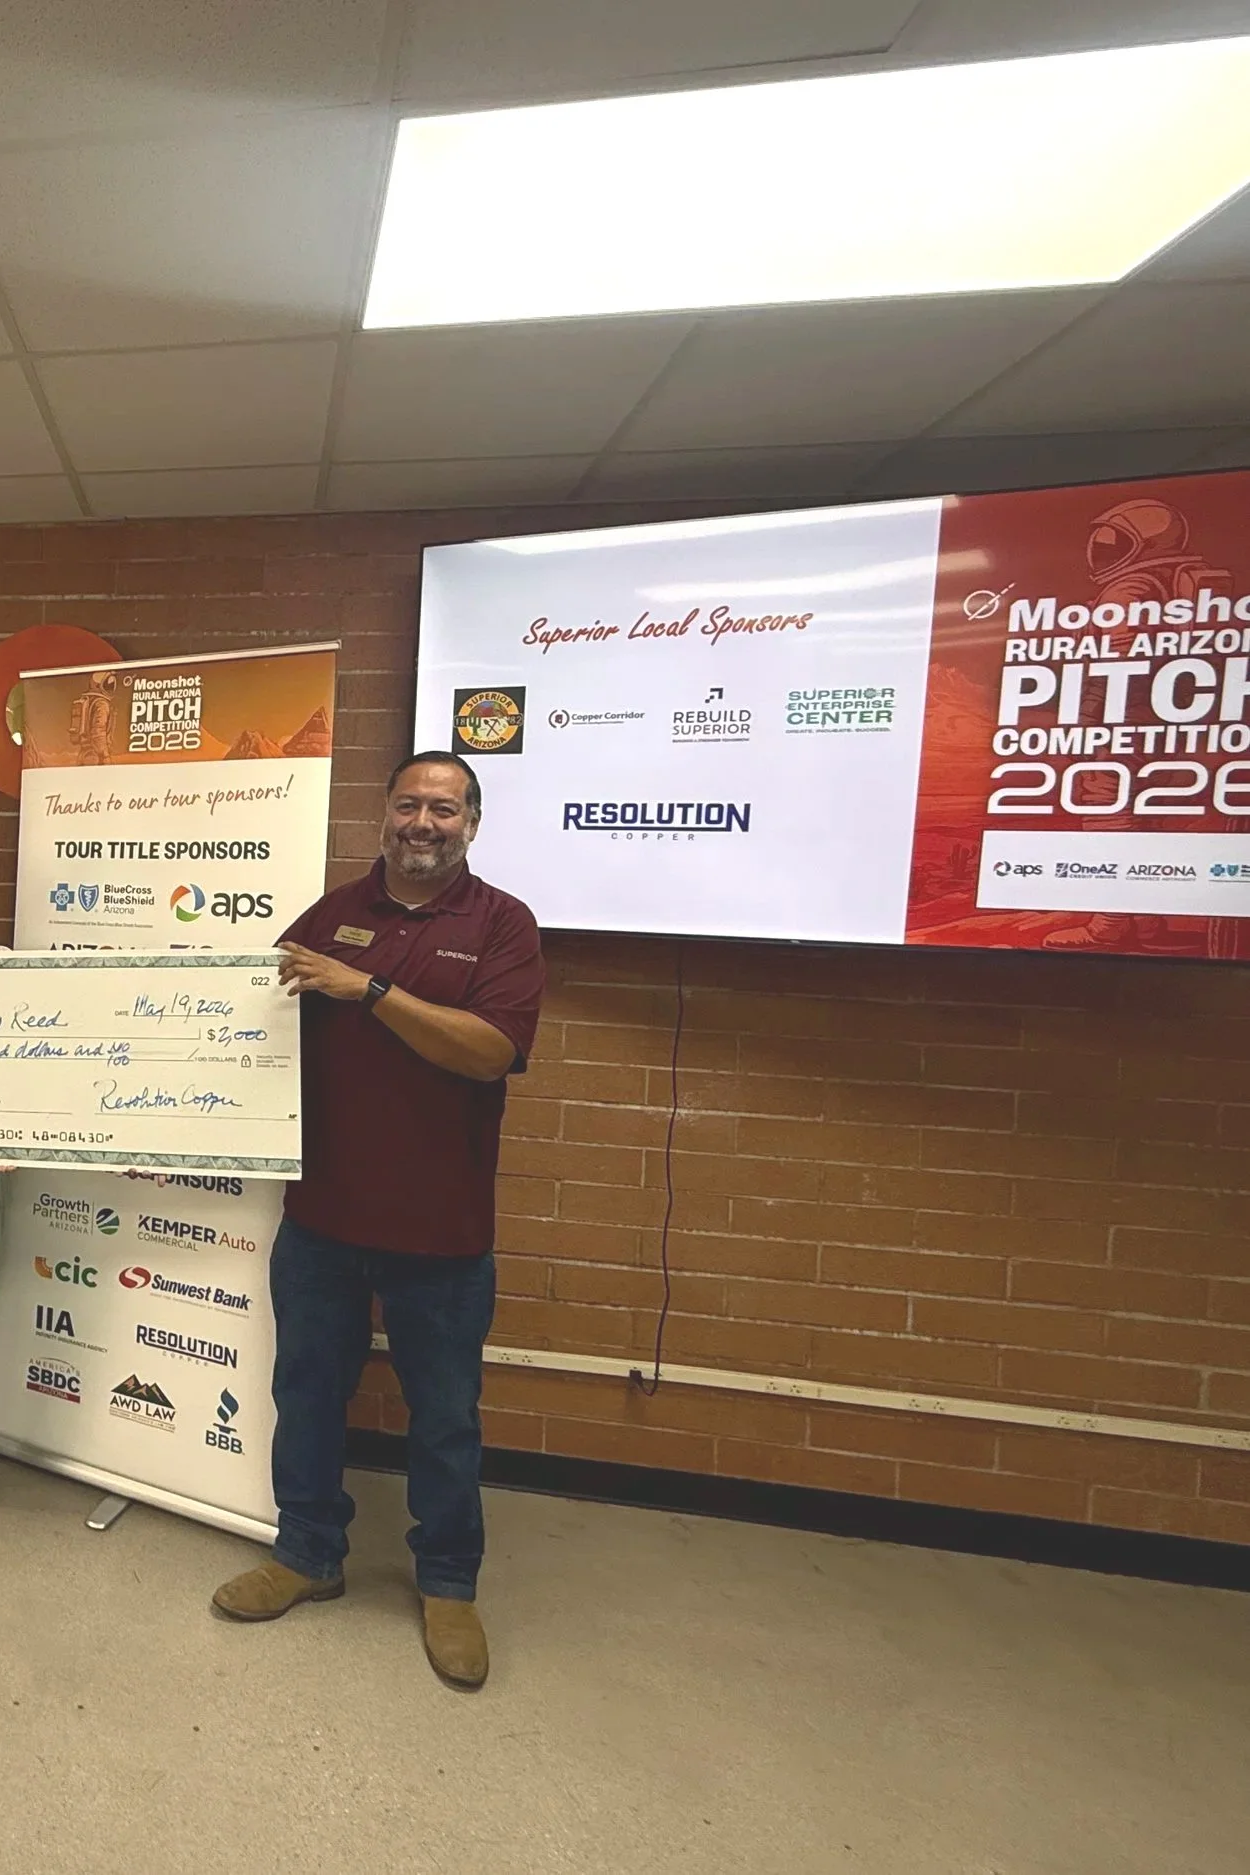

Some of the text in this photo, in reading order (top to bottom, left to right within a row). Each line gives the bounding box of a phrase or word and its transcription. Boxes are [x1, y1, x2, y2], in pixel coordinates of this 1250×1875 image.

[523, 606, 813, 654] Superior Local Sponsors
[1005, 635, 1119, 662] RURAL
[133, 688, 201, 700] RURAL ARIZONA
[466, 693, 512, 709] SUPERIOR
[788, 688, 895, 701] SUPERIOR
[997, 657, 1250, 726] PITCH
[131, 697, 201, 722] PITCH
[785, 700, 896, 711] ENTERPRISE
[130, 719, 199, 733] COMPETITION
[571, 711, 644, 722] Copper Corridor
[673, 710, 751, 724] REBUILD
[786, 710, 893, 728] CENTER
[672, 724, 750, 735] SUPERIOR
[129, 730, 201, 752] 2026
[467, 737, 507, 748] ARIZONA
[45, 774, 294, 816] Thanks to our tour sponsors!
[563, 803, 751, 832] RESOLUTION
[611, 832, 695, 841] COPPER
[55, 841, 271, 860] TOUR TITLE SPONSORS
[1014, 864, 1043, 877] aps
[1070, 863, 1118, 874] OneAZ
[1126, 864, 1197, 876] ARIZONA
[104, 884, 152, 895] BlueCross
[103, 905, 135, 915] Arizona
[104, 895, 155, 906] BlueShield
[211, 892, 273, 924] aps
[436, 949, 478, 963] SUPERIOR
[251, 976, 270, 986] 022
[10, 1002, 68, 1031] Reed
[133, 992, 166, 1024] May
[15, 1040, 68, 1058] dollars
[73, 1042, 105, 1056] and
[40, 1193, 89, 1213] Growth
[33, 1203, 89, 1225] Partners
[50, 1221, 89, 1234] ARIZONA
[138, 1214, 256, 1253] KEMPER Auto
[137, 1231, 198, 1252] COMMERCIAL
[54, 1256, 98, 1288] cic
[151, 1273, 211, 1301] Sunwest
[213, 1287, 250, 1311] Bank
[36, 1304, 74, 1337] IIA
[136, 1324, 238, 1369] RESOLUTION
[27, 1365, 80, 1393] SBDC
[110, 1394, 141, 1412] AWD
[146, 1404, 176, 1421] LAW
[205, 1430, 243, 1454] BBB
